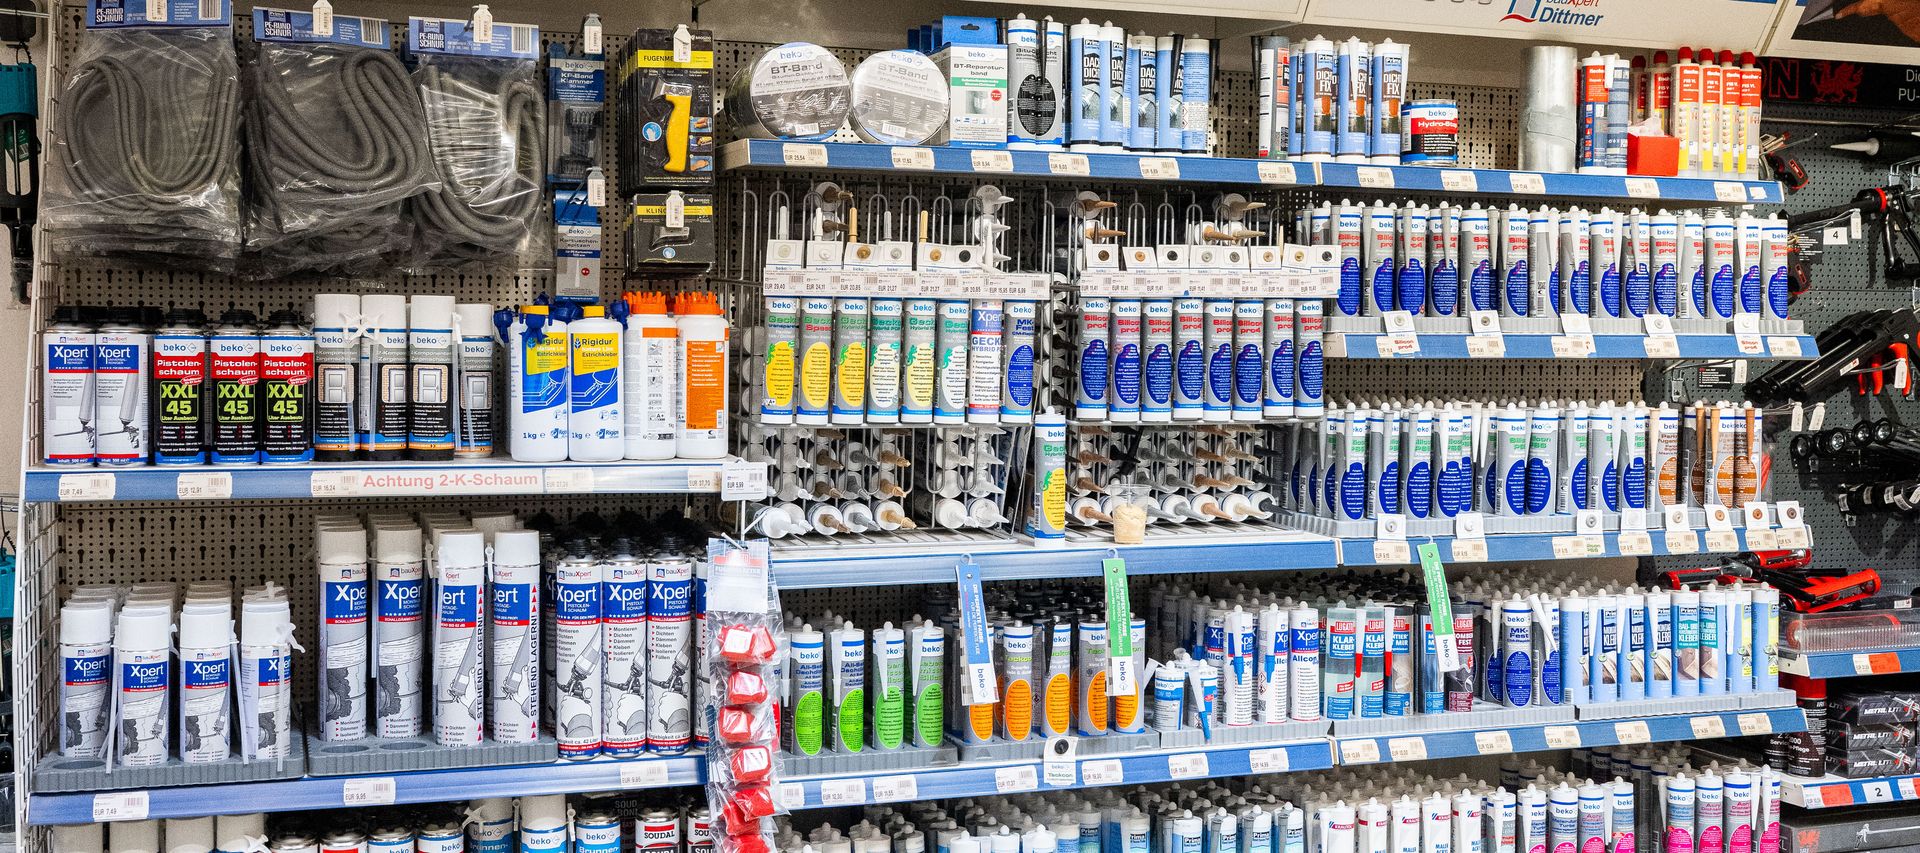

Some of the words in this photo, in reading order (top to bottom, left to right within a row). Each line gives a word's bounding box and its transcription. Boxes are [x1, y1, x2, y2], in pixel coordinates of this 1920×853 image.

[96, 14, 124, 22] SCHNUR
[1539, 7, 1603, 26] Dittmer
[264, 22, 291, 30] PE-RUND
[265, 29, 291, 37] SCHNUR
[420, 33, 444, 42] PE-RUND
[420, 40, 444, 48] SCHNUR
[780, 50, 802, 60] beko
[771, 62, 823, 74] BT-Band
[1320, 81, 1332, 92] FIX
[1387, 84, 1400, 95] FIX
[1832, 231, 1839, 240] 4
[582, 338, 612, 347] Rigidur
[54, 346, 88, 364] Xpert
[98, 346, 130, 364] Xpert
[161, 384, 198, 398] XXL
[218, 384, 254, 398] XXL
[268, 384, 303, 398] XXL
[166, 400, 192, 414] 45
[224, 400, 249, 414] 45
[273, 400, 298, 414] 45
[364, 474, 434, 489] Achtung
[440, 474, 538, 487] 2-K-Schaum
[566, 570, 591, 580] bauXpert
[556, 585, 597, 612] Xpert
[74, 658, 106, 676] Xpert
[131, 664, 164, 683] Xpert
[193, 662, 225, 680] Xpert
[978, 668, 986, 688] beko
[1875, 788, 1882, 797] 2
[644, 831, 675, 839] SOUDAL
[442, 843, 461, 852] beko
